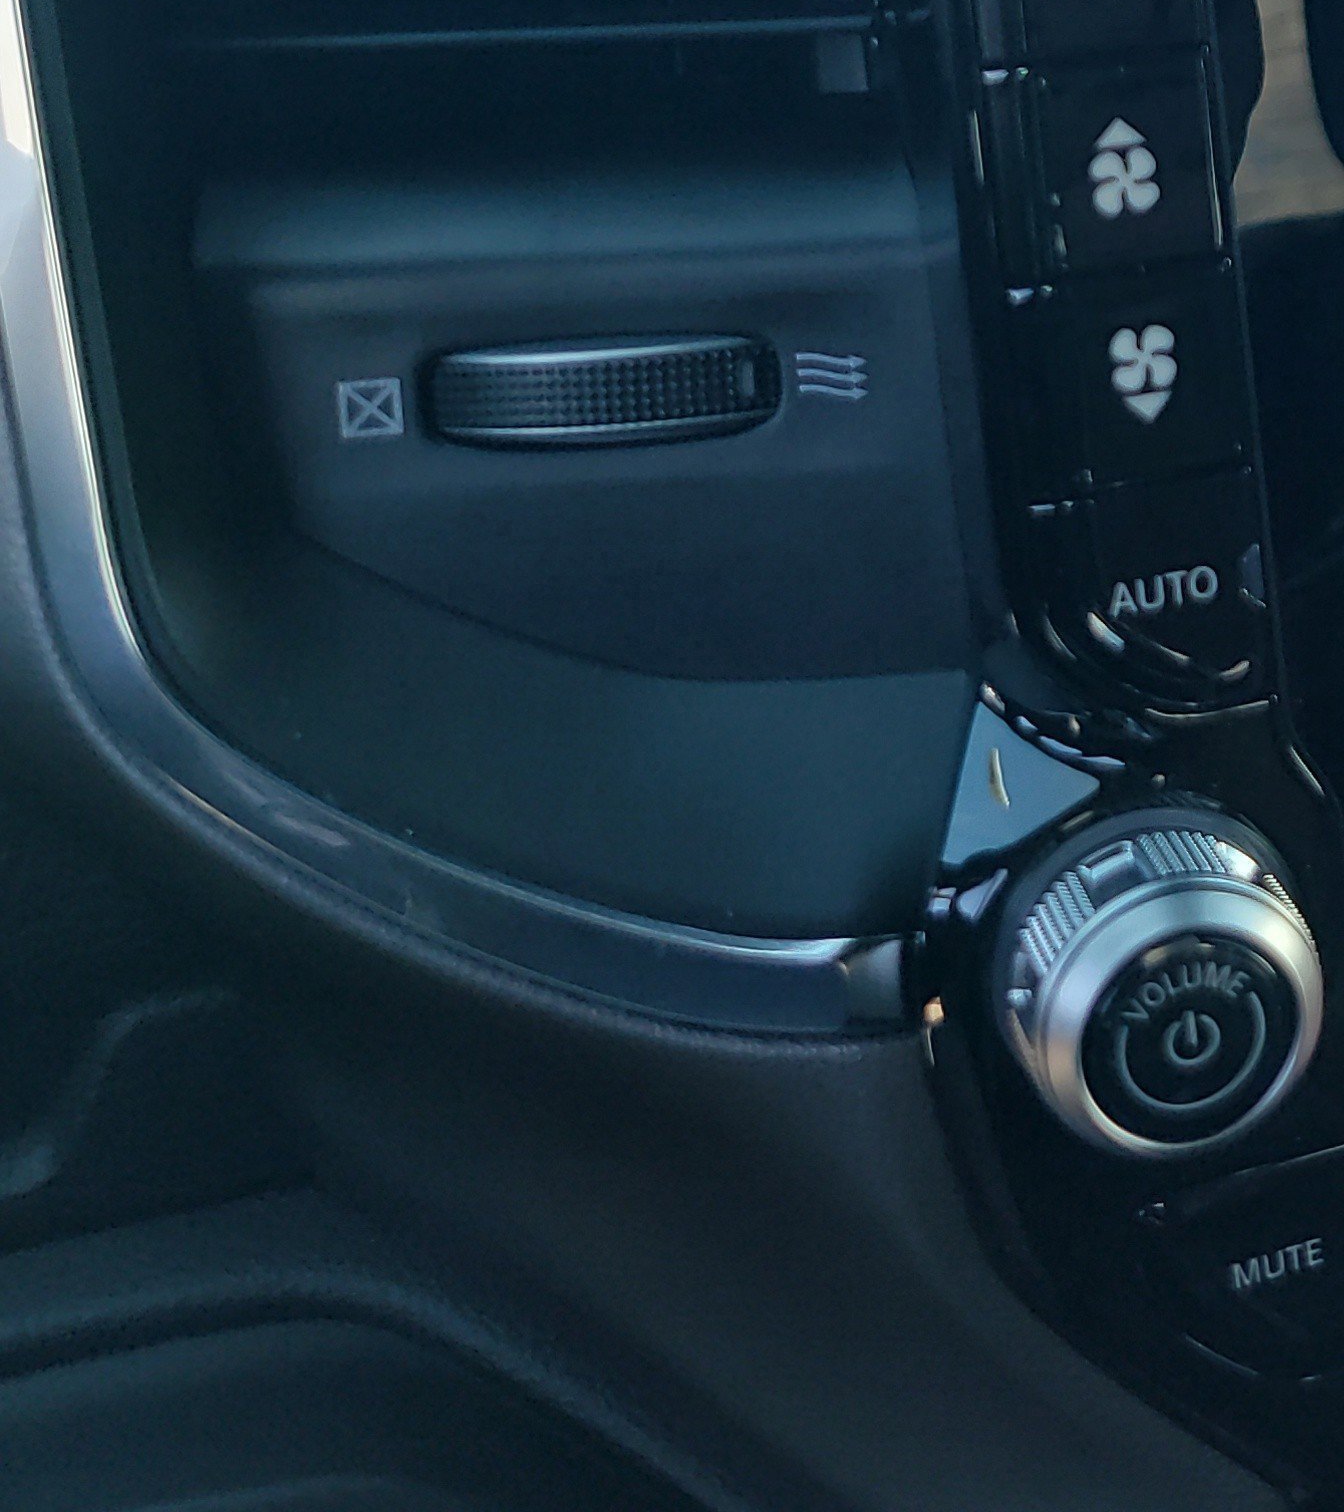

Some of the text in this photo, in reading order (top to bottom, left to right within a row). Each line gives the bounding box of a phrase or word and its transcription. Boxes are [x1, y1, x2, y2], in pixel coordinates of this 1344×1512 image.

[1109, 565, 1219, 616] AUTO
[1122, 961, 1252, 1023] VOLUME
[1230, 1237, 1326, 1289] MUTE
